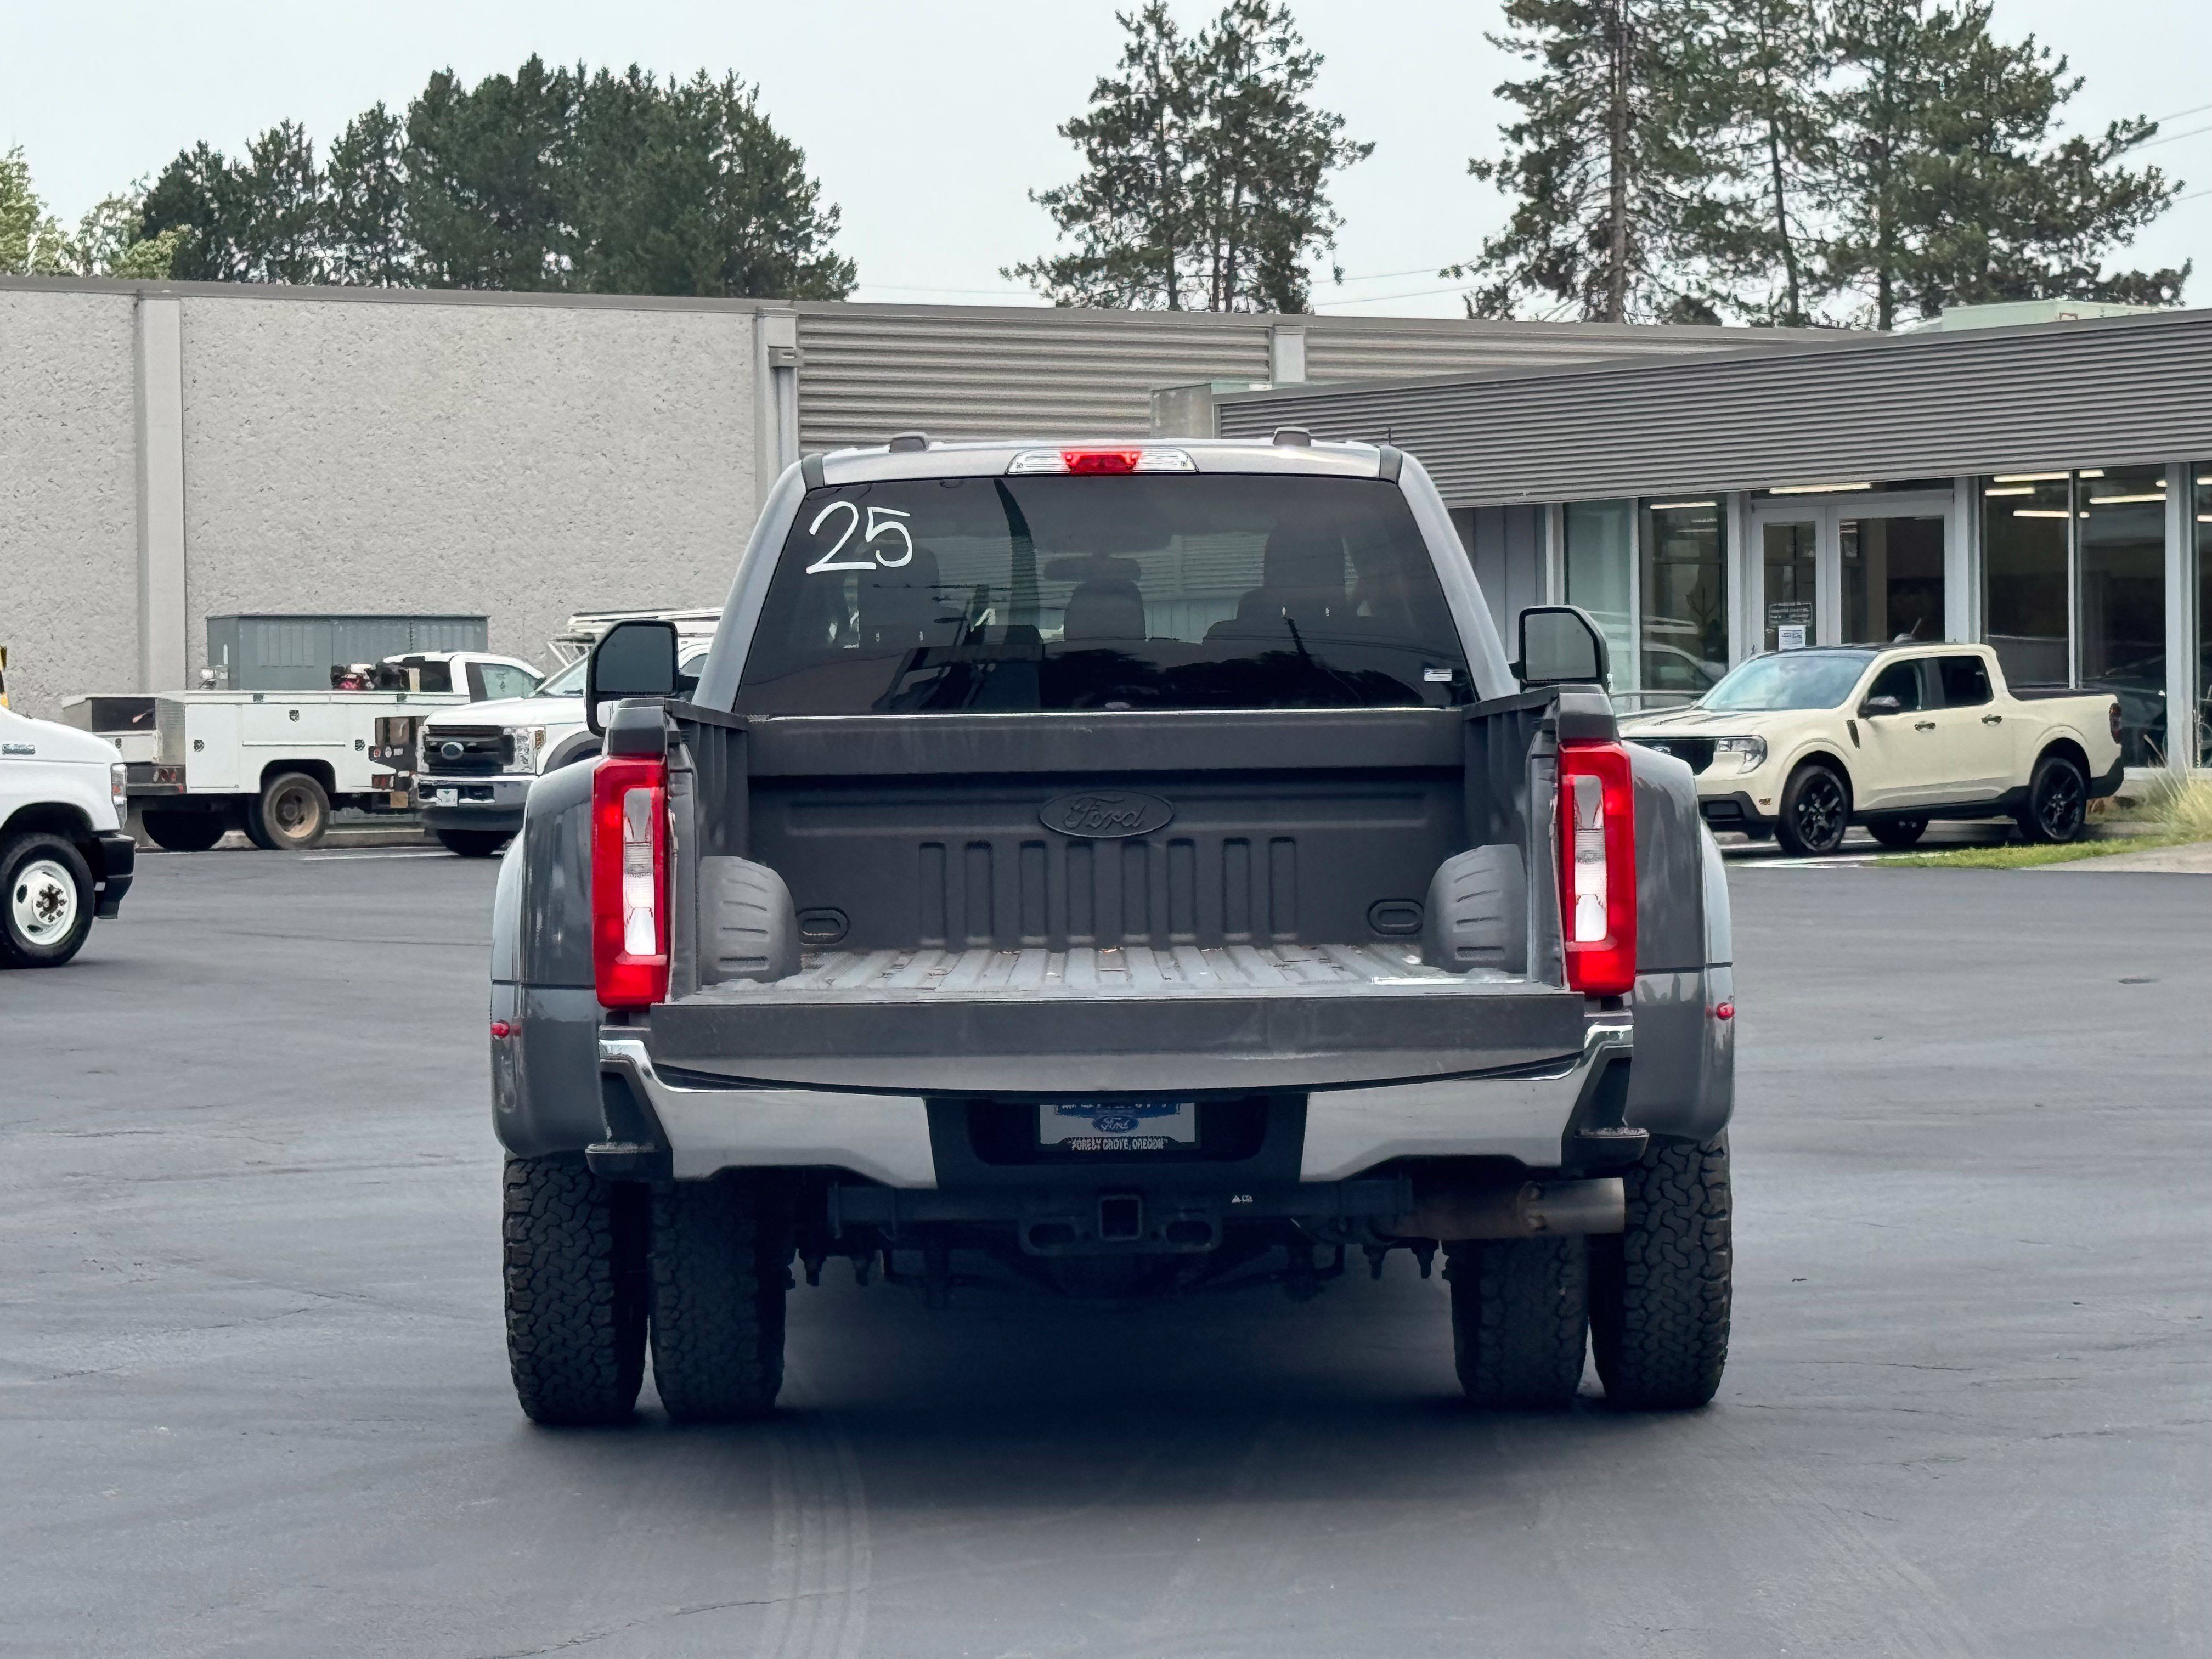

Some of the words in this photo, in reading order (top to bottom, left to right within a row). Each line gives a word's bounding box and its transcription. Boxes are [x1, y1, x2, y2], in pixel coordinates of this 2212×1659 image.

[806, 501, 913, 574] 25
[1063, 797, 1147, 830] Ford
[1101, 1117, 1130, 1131] Ford
